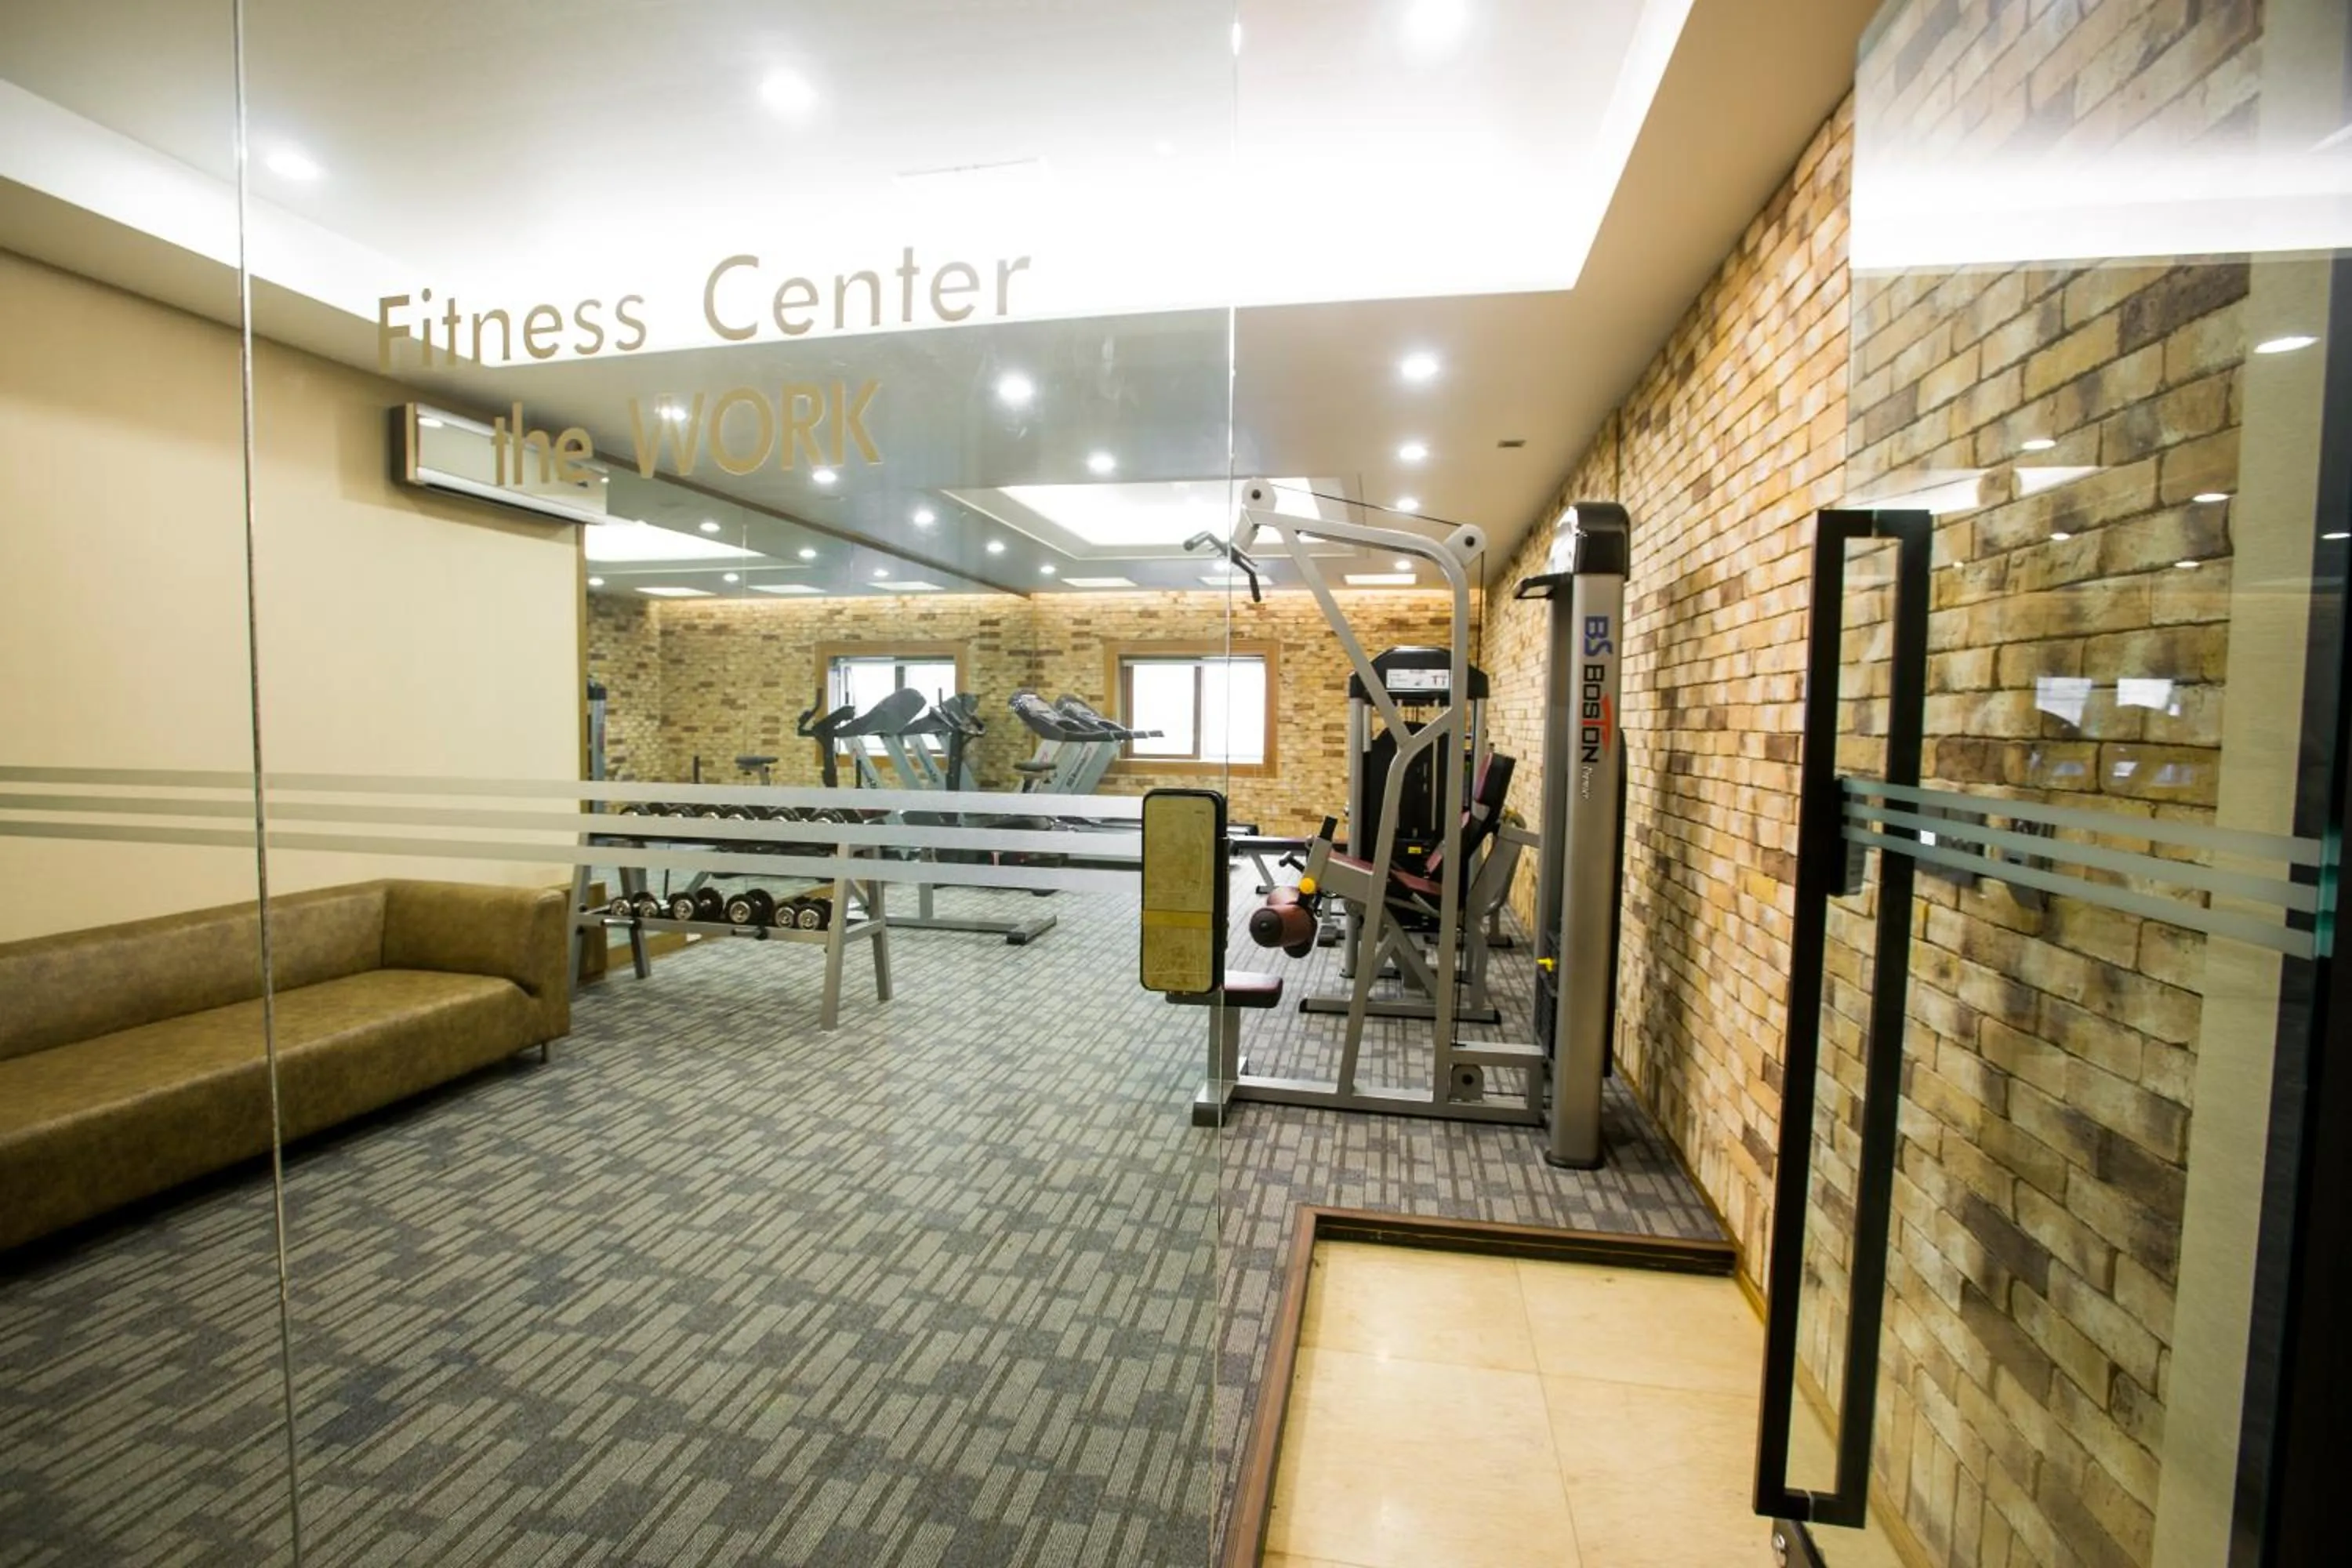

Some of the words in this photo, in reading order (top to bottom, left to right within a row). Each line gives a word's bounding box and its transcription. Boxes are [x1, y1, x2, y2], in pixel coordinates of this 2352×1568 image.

[378, 287, 647, 370] Fitness
[703, 245, 1032, 341] Center
[490, 401, 594, 487] the
[627, 378, 884, 479] WORK
[1584, 615, 1613, 657] BS
[1581, 664, 1612, 764] BOSTON
